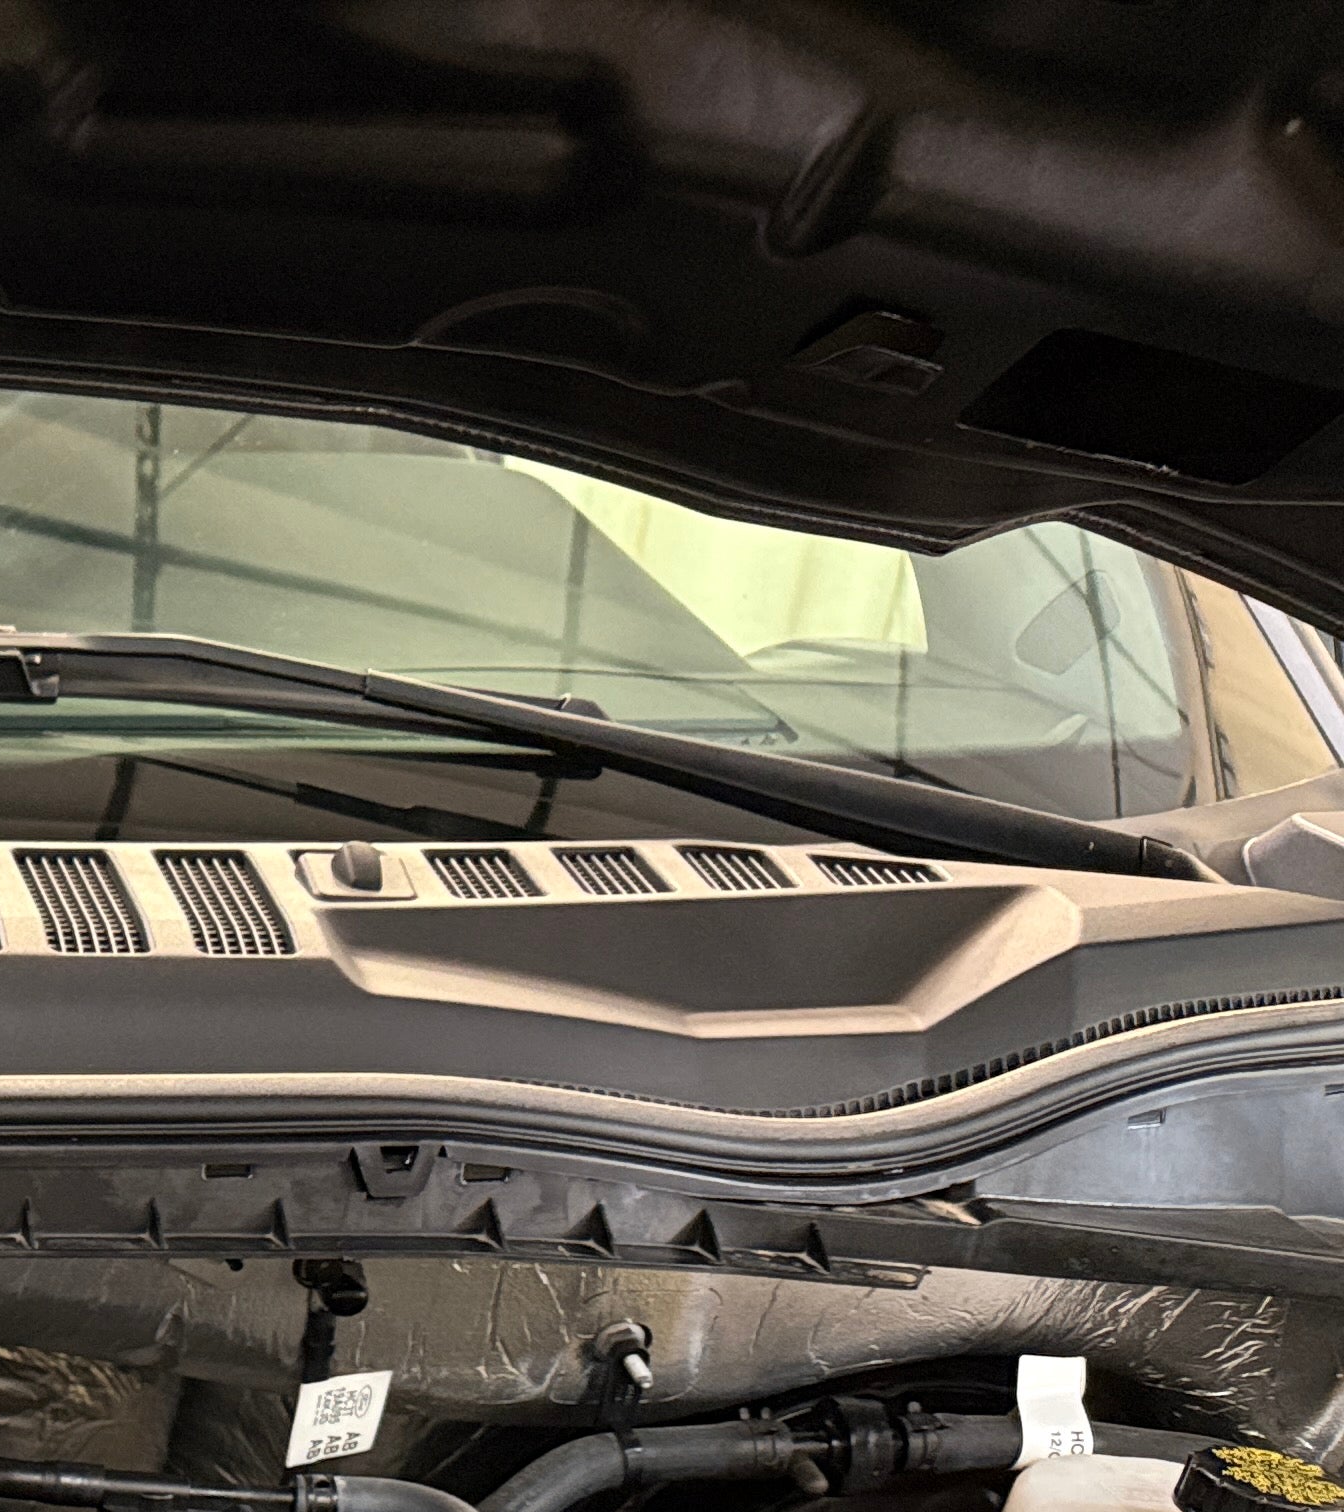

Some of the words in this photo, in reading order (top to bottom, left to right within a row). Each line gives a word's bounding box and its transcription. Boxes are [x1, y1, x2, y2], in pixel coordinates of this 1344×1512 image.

[307, 1440, 323, 1460] AB
[324, 1435, 342, 1455] AB
[342, 1432, 361, 1452] AB
